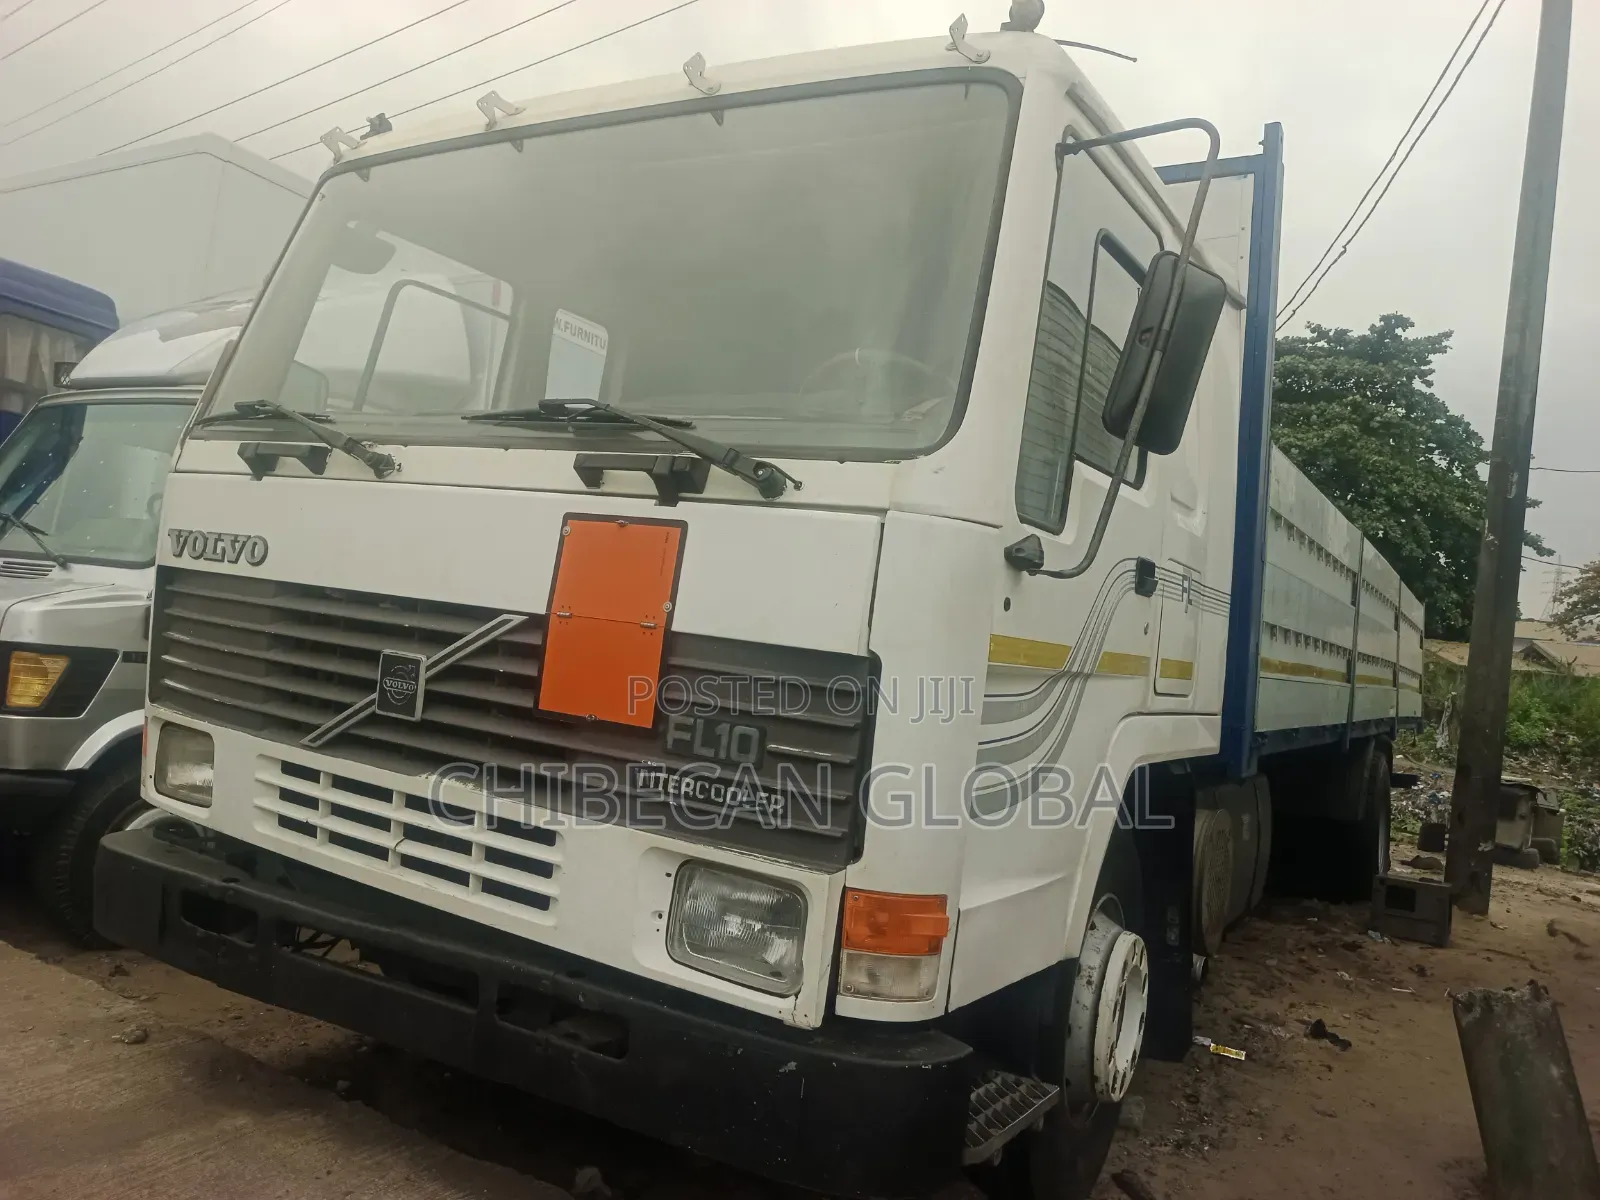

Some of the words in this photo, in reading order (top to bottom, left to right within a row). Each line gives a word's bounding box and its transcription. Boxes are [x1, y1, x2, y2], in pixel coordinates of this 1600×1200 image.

[168, 528, 268, 567] VOLVO
[385, 679, 414, 691] VOLVO
[666, 714, 760, 764] FL10
